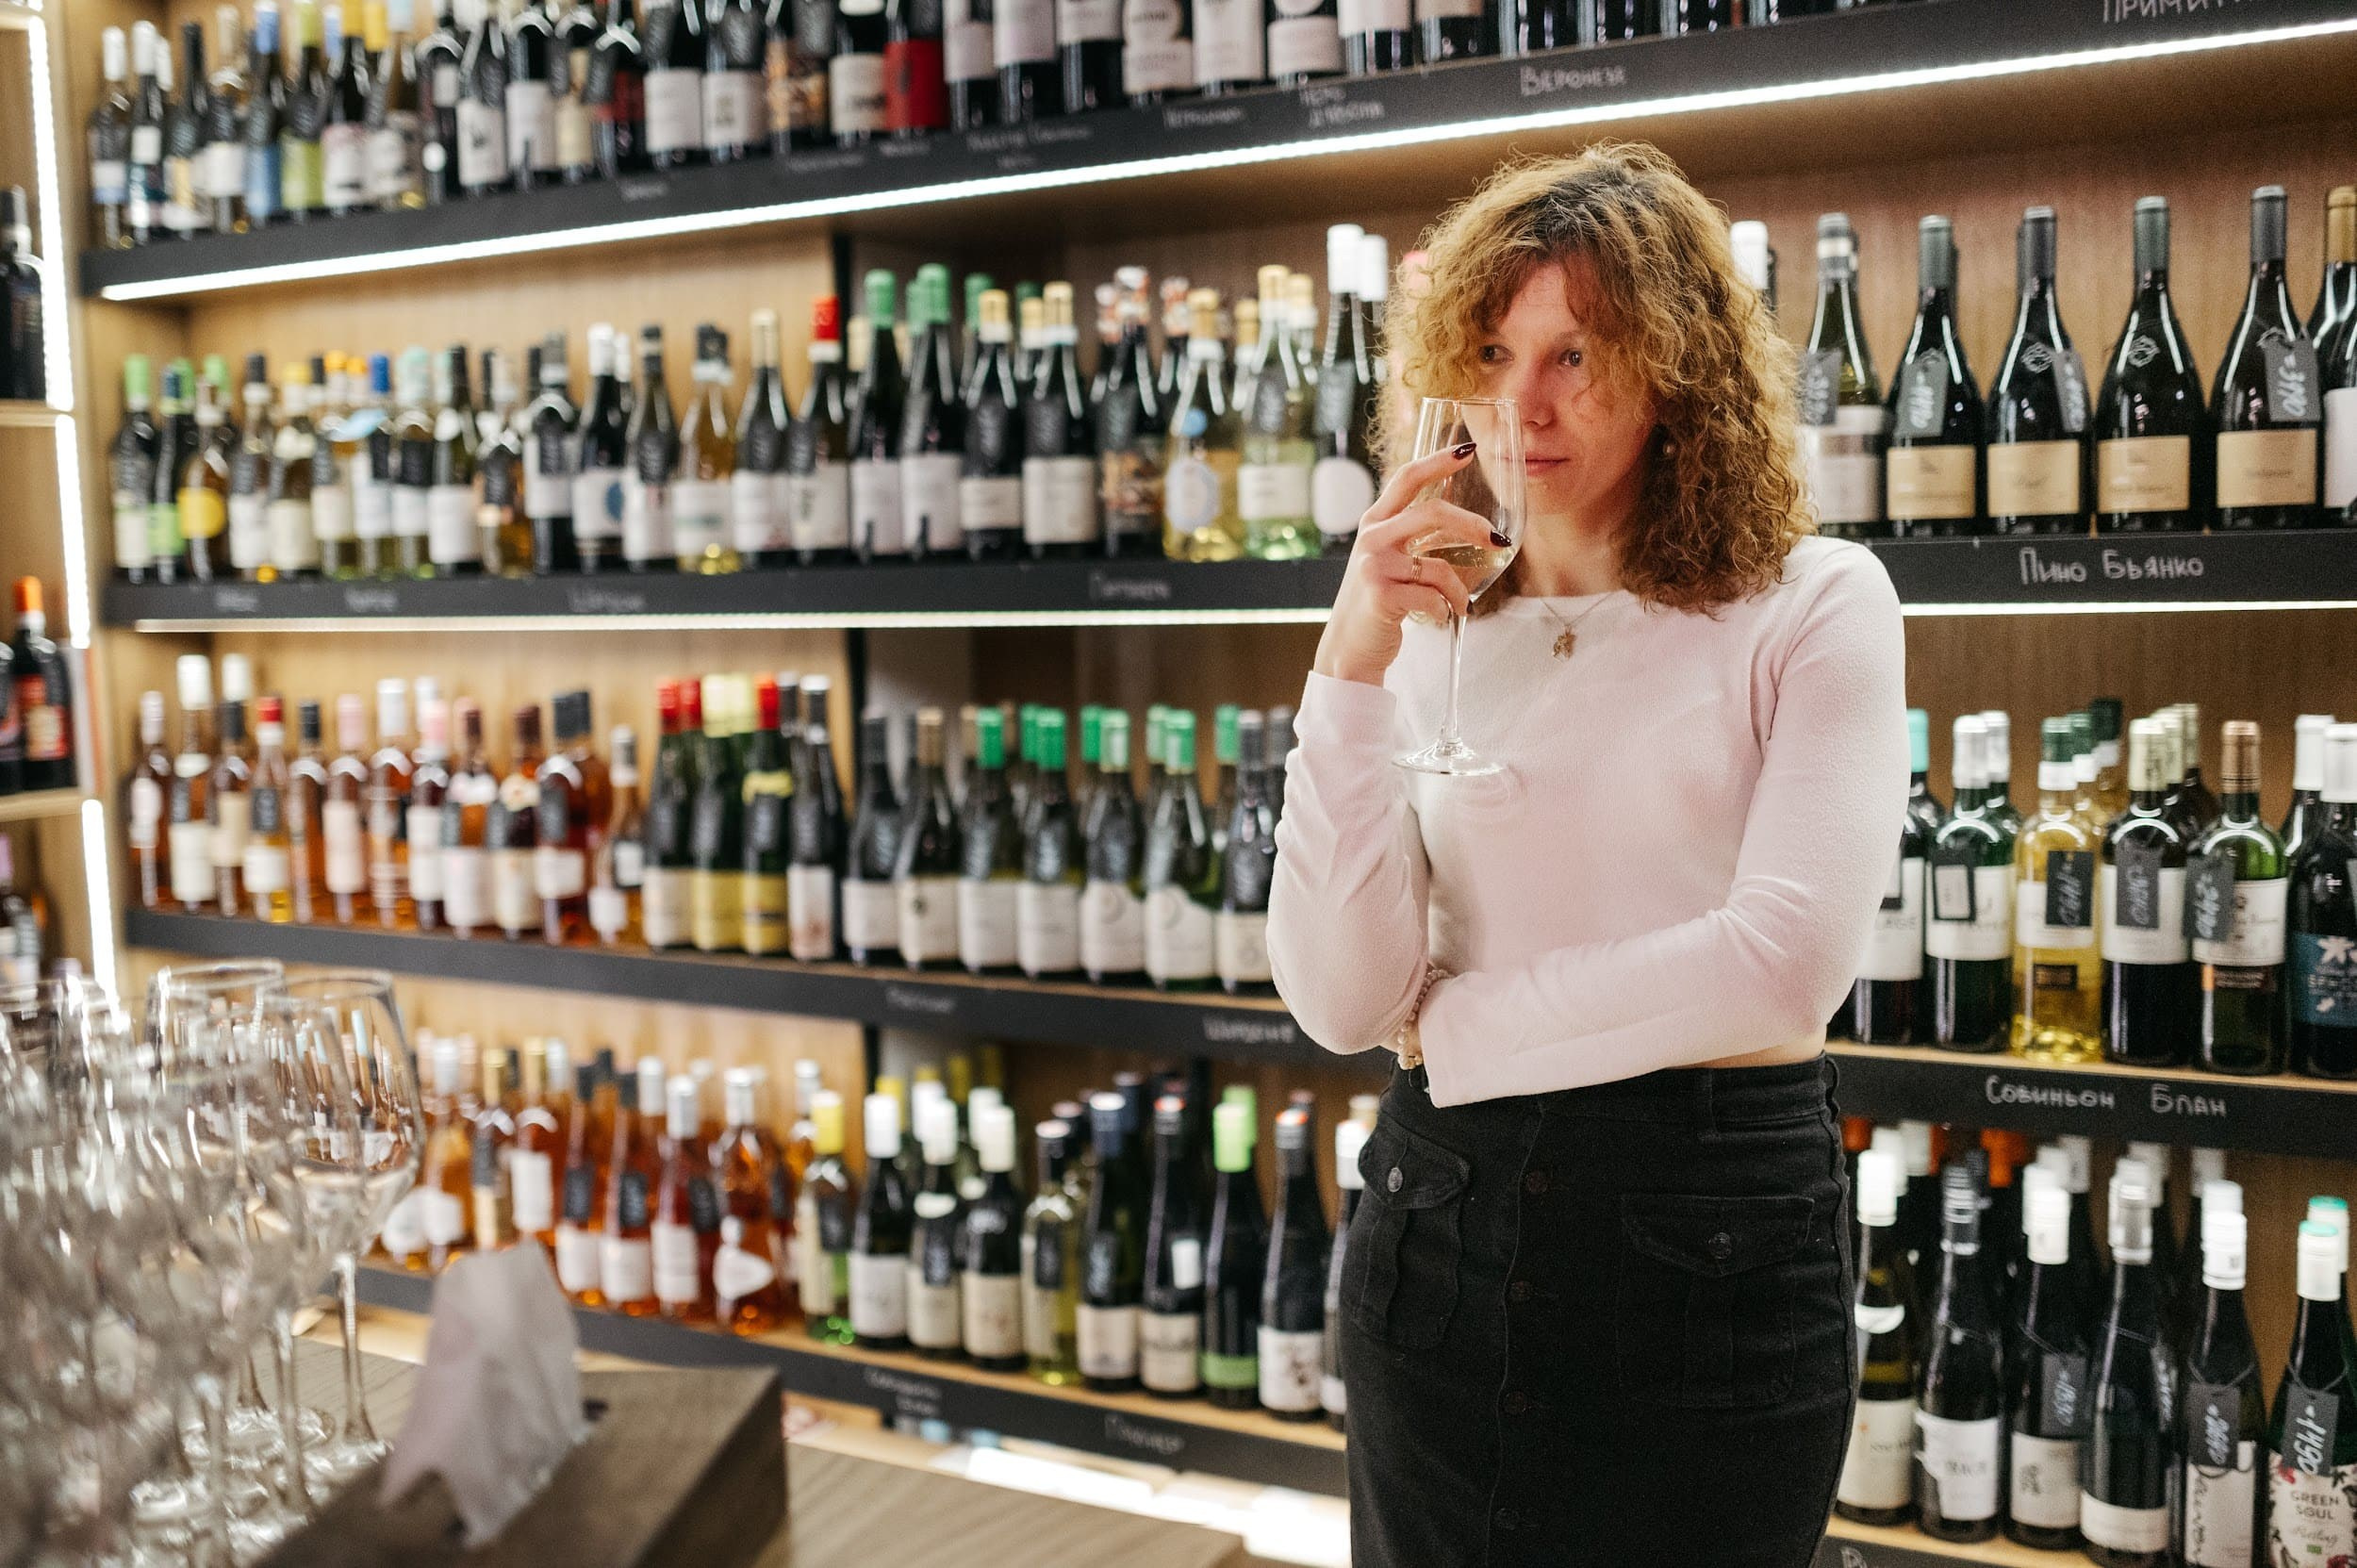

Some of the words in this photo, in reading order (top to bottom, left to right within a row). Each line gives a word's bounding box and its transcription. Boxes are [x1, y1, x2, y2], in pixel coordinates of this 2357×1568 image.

[2019, 546, 2087, 585] Пино
[2102, 549, 2204, 580] Бьянко
[1986, 1075, 2116, 1109] Совиньон
[2151, 1083, 2227, 1117] Блан
[2292, 1492, 2339, 1506] GREEN
[2296, 1506, 2333, 1520] SOUL
